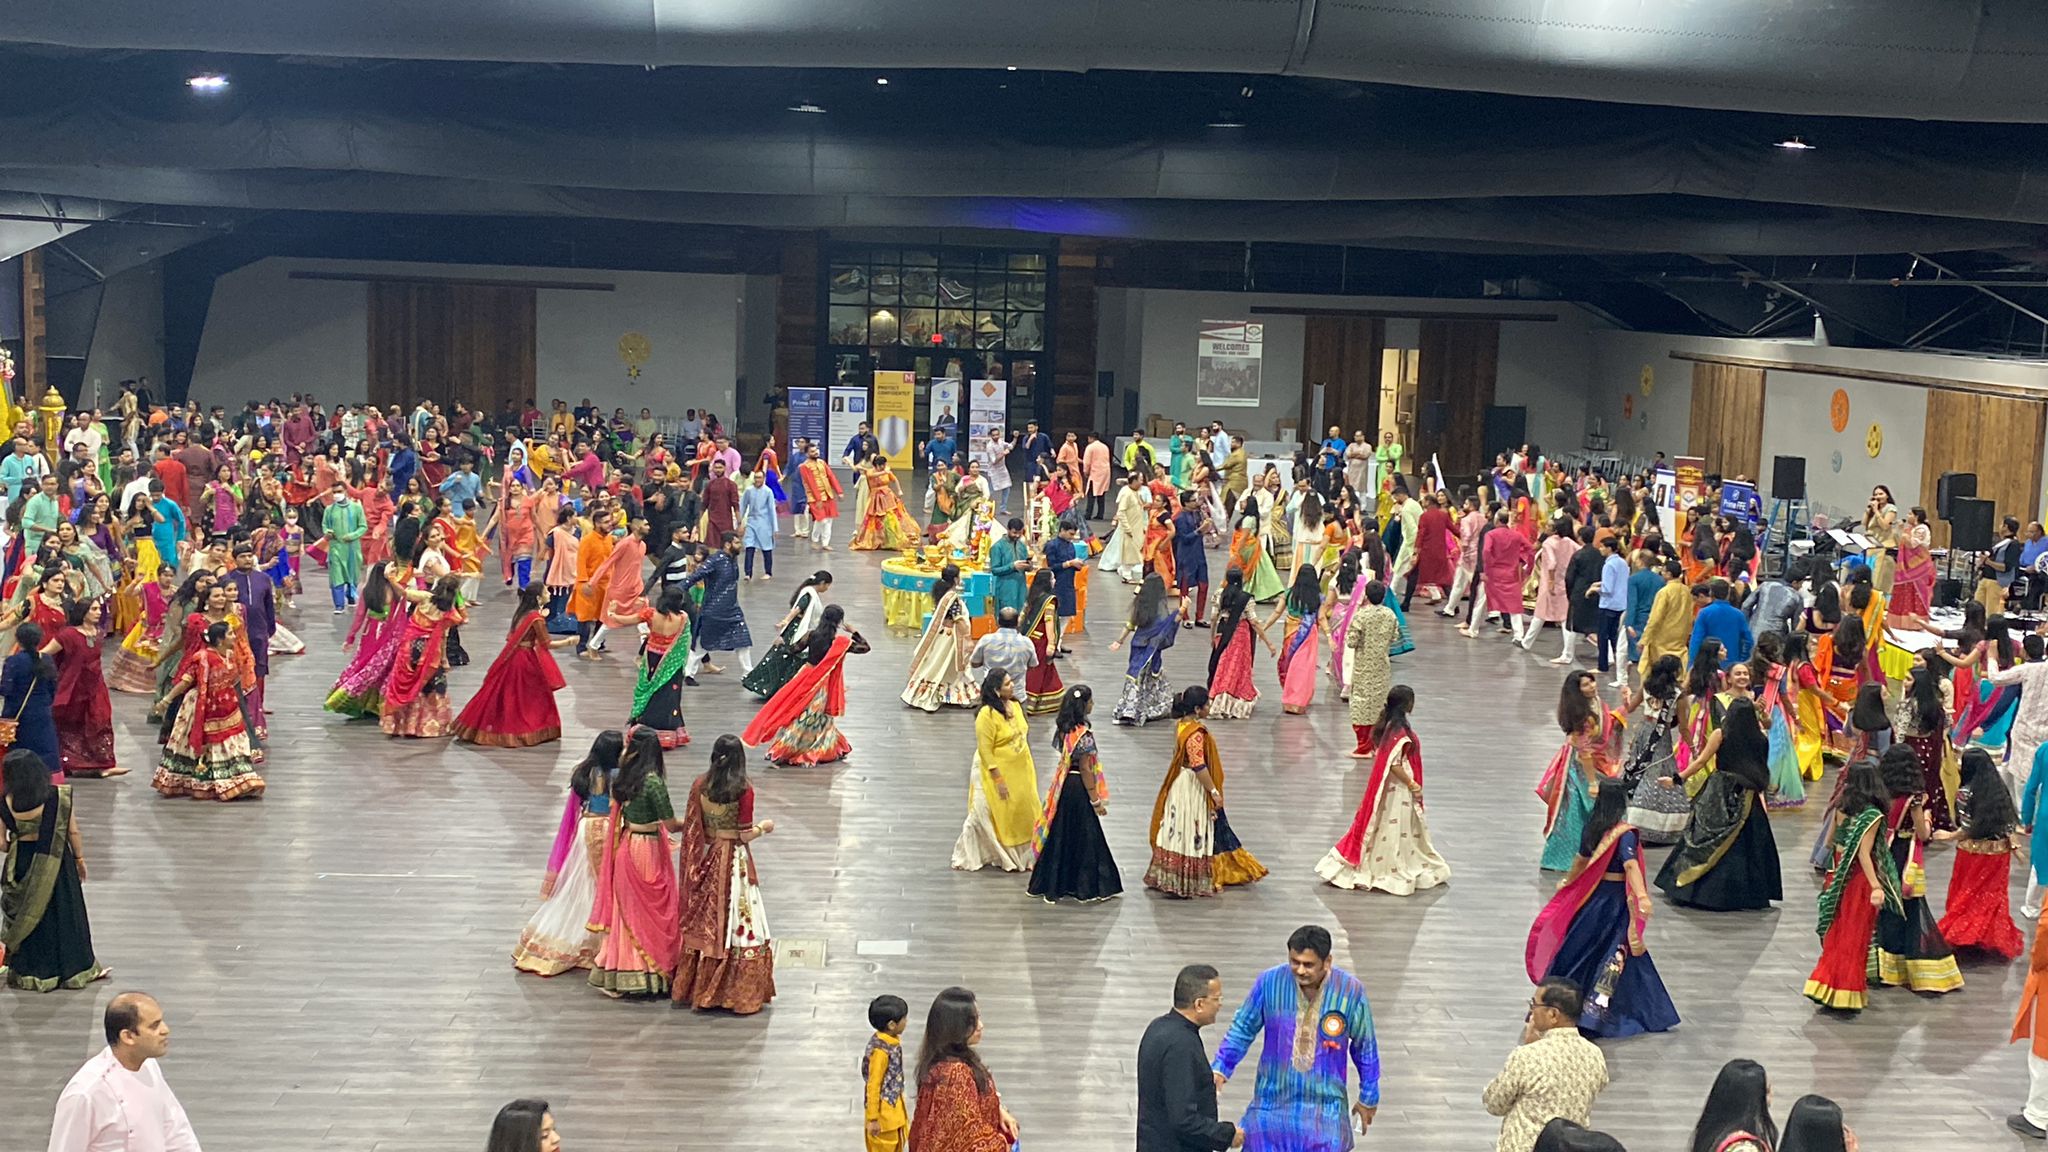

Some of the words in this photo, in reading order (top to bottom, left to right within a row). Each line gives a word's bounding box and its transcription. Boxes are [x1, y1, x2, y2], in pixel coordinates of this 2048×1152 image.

[1212, 343, 1250, 351] WELCOMES
[904, 374, 913, 382] M
[1723, 498, 1737, 508] Prime
